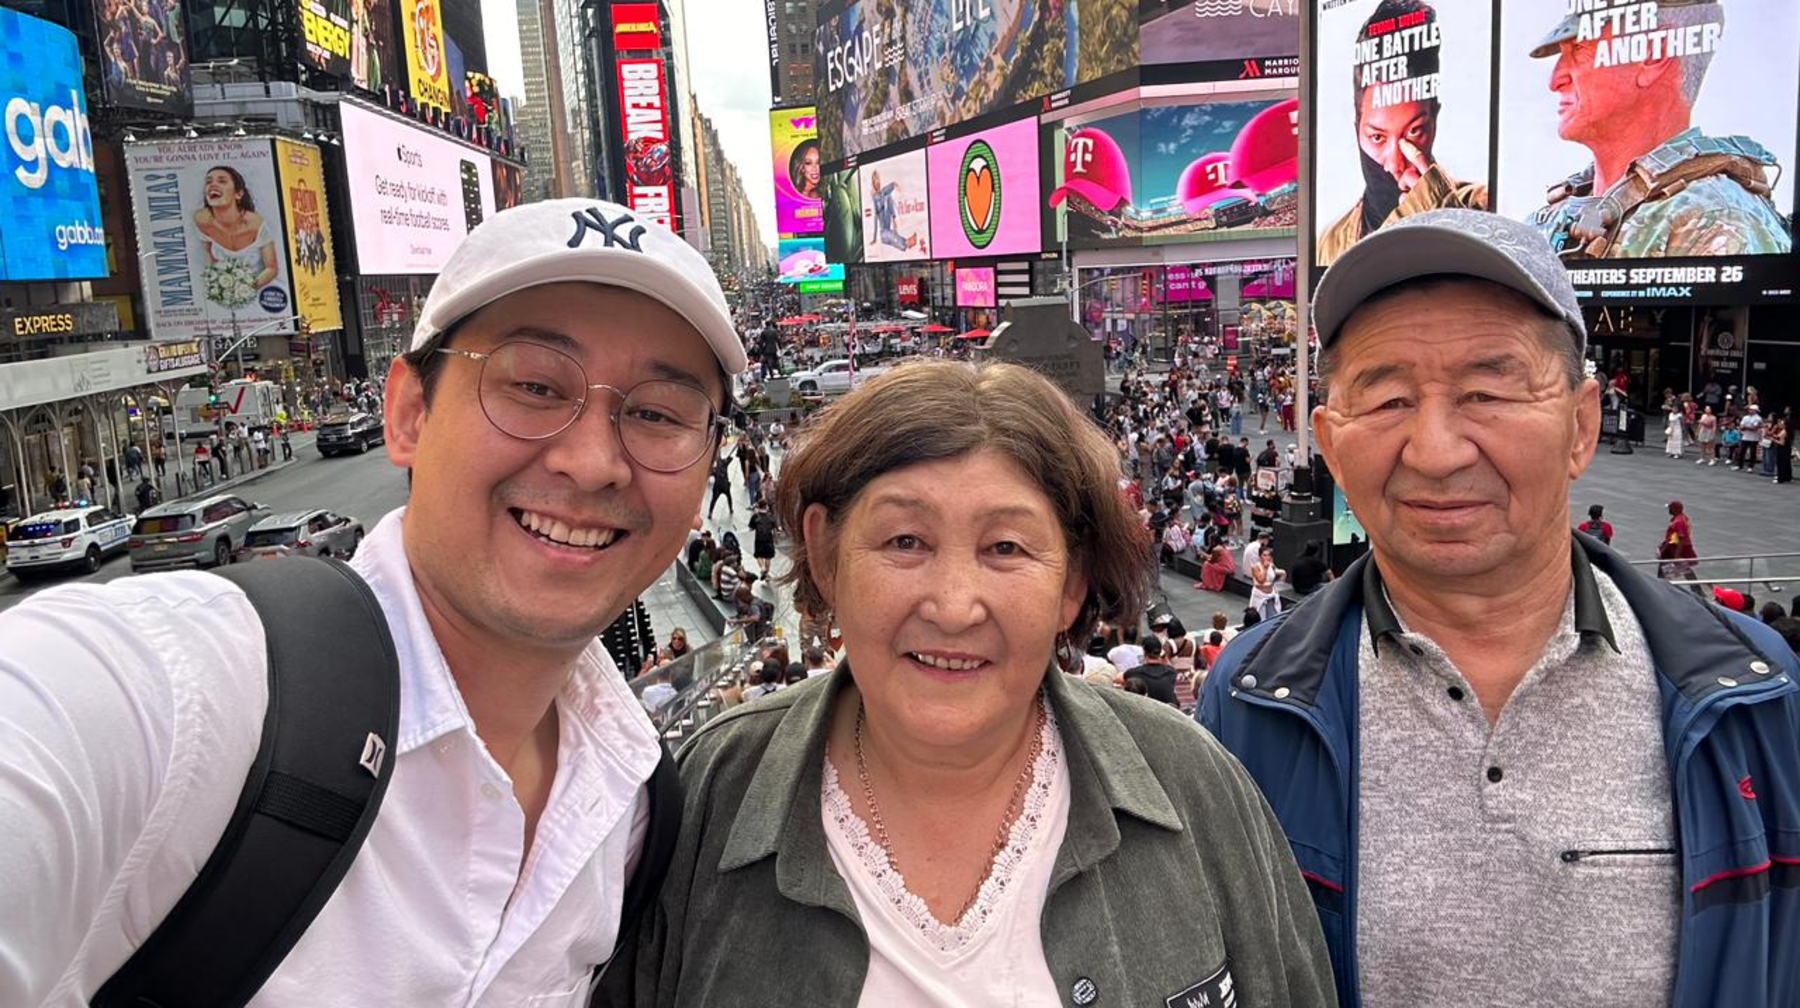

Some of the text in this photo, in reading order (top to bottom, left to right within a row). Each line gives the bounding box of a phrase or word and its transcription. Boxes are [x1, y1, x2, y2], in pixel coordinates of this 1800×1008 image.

[1576, 2, 1658, 42] AFTER
[827, 24, 882, 92] ESCAPE
[1353, 21, 1440, 66] ONE BATTLE
[1594, 23, 1721, 68] ANOTHER
[1361, 55, 1408, 88] AFTER
[621, 63, 664, 139] BREAK
[1372, 73, 1440, 109] ANOTHER
[166, 154, 197, 162] GONNA
[240, 150, 270, 159] AGAIN!
[218, 142, 243, 151] KNOW
[402, 145, 423, 168] Sports
[144, 172, 183, 221] MIA!
[375, 174, 389, 195] Get
[390, 180, 407, 203] ready
[567, 207, 647, 253] NY
[152, 226, 194, 307] MAMMA
[1566, 266, 1744, 285] THEATERS SEPTEMBER 26
[1646, 286, 1693, 297] IMAX
[14, 313, 74, 336] EXPRESS
